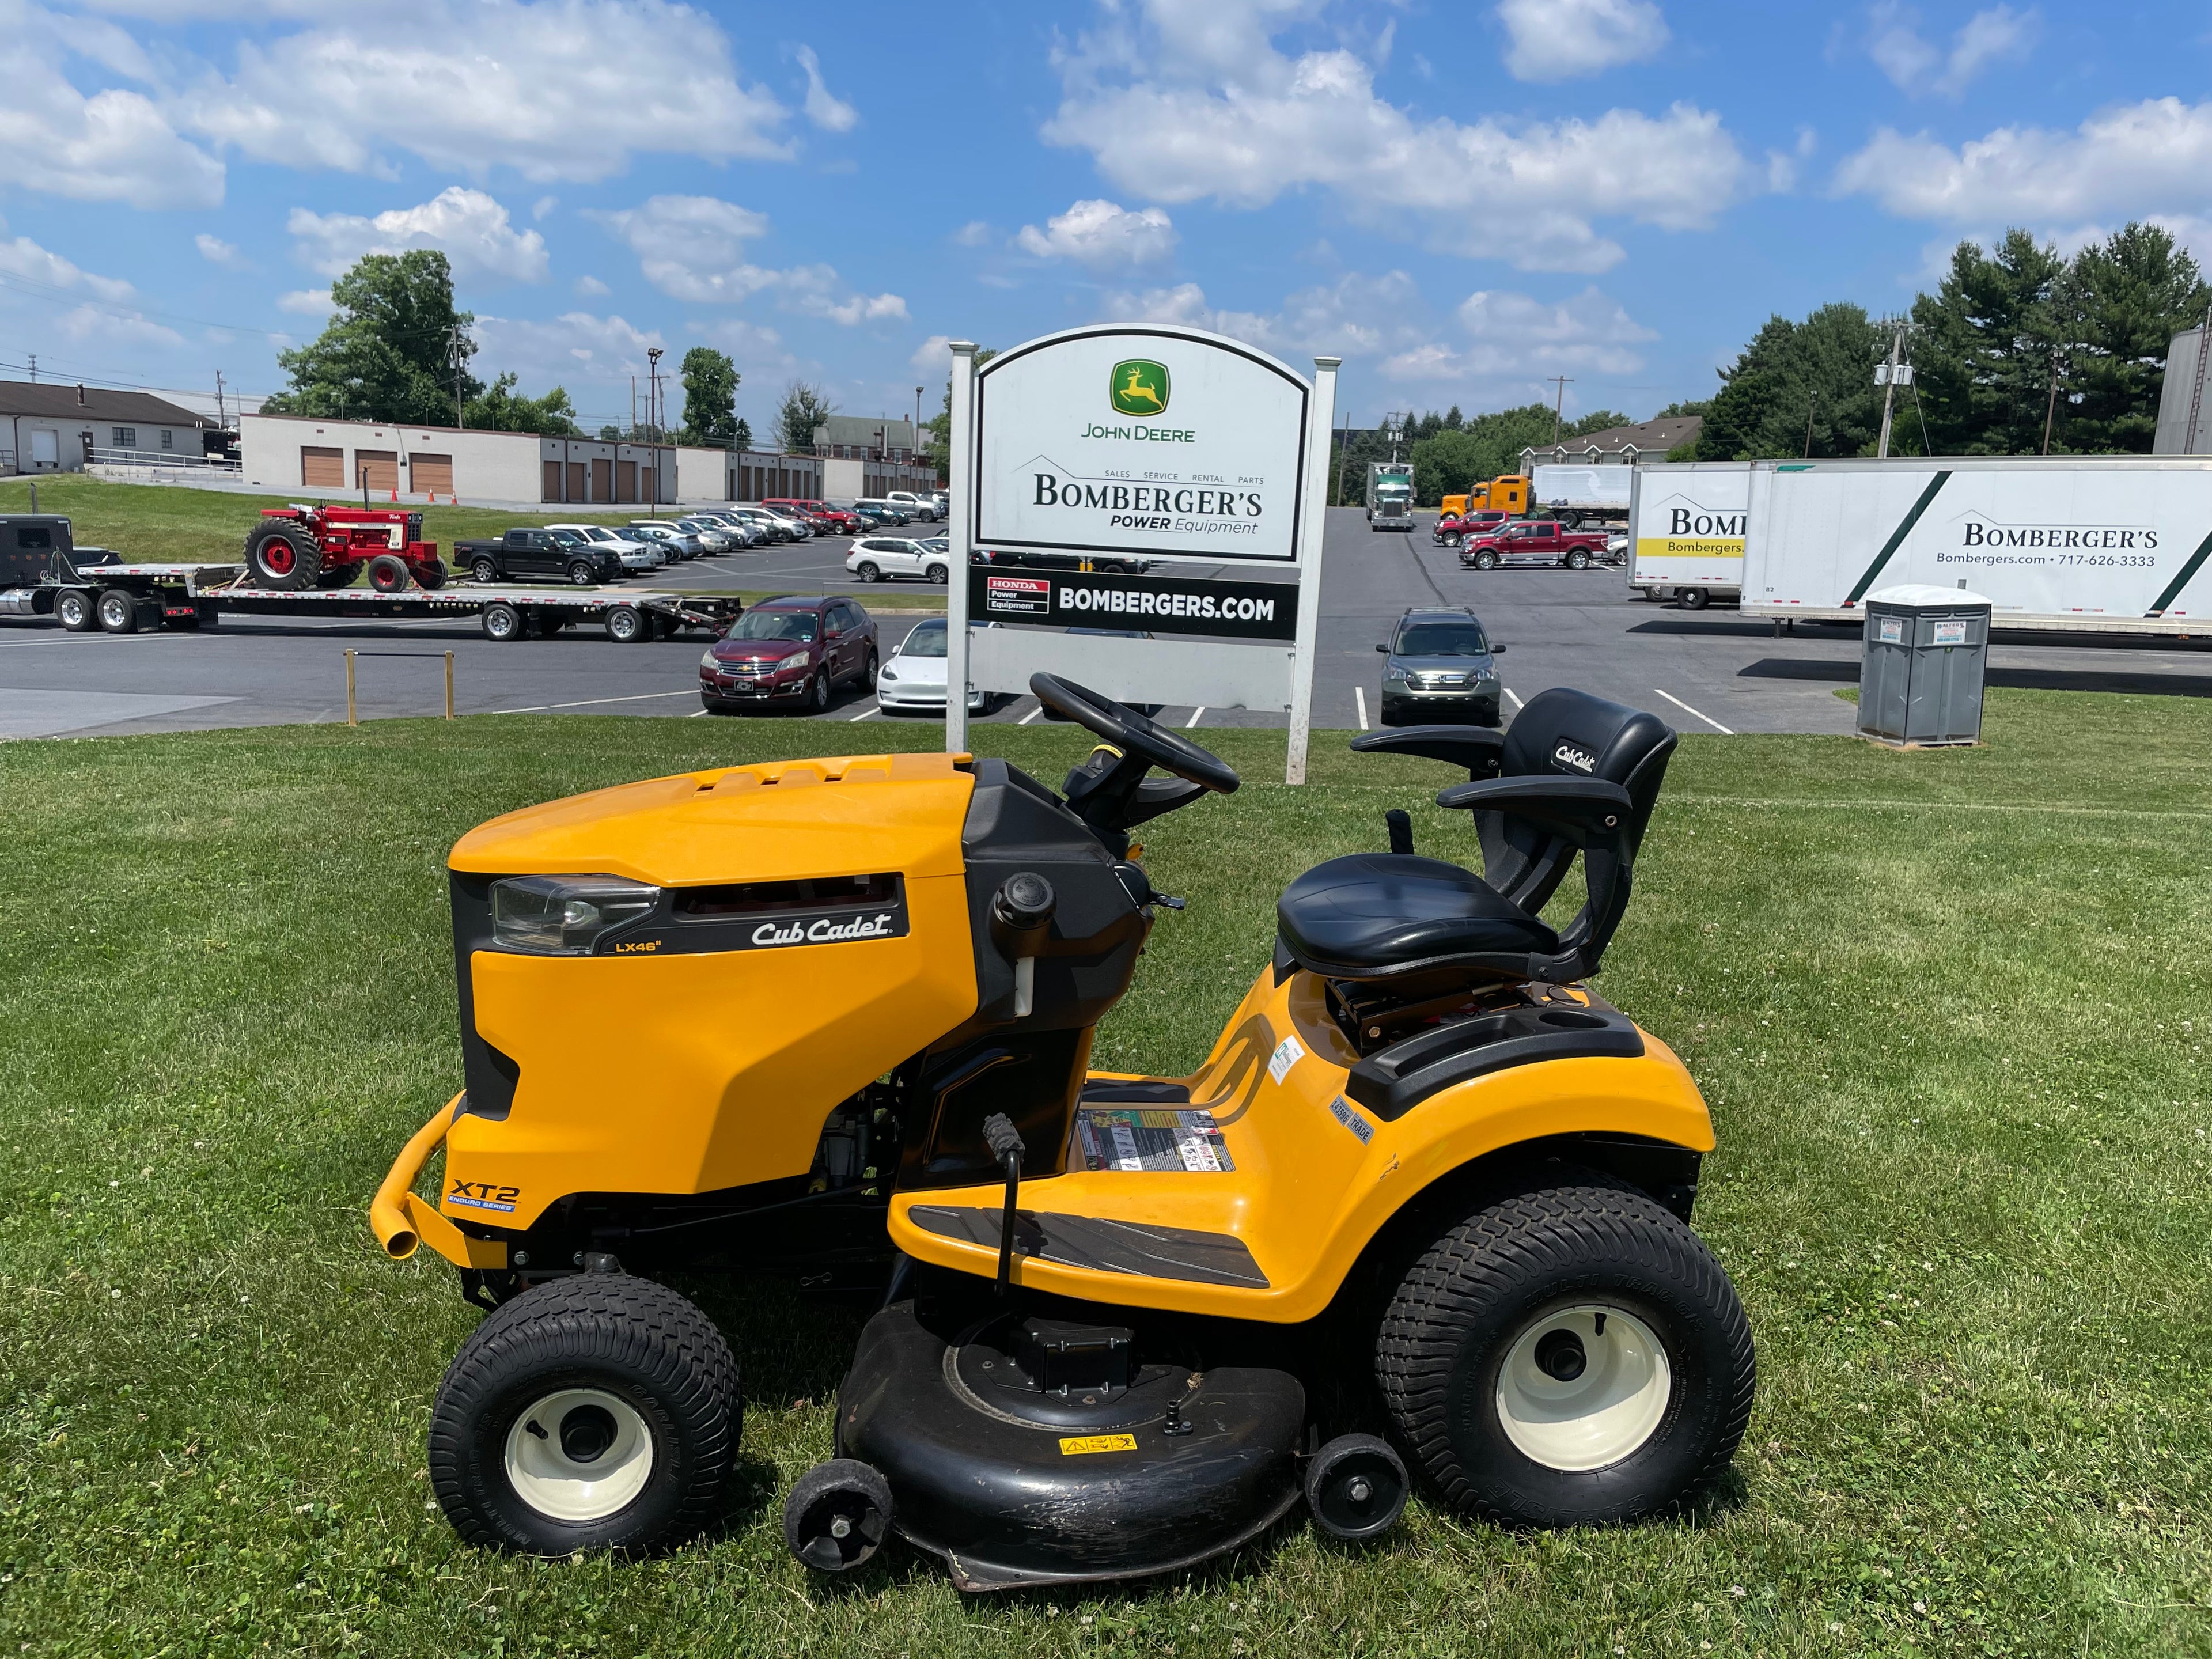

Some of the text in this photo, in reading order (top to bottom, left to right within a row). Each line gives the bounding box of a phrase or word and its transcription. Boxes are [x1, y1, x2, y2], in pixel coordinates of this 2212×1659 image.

[1081, 423, 1195, 442] JOHN DEERE
[1105, 469, 1264, 484] SALES SERVICE RENTAL PARTS
[1033, 474, 1263, 516] BOMBERGER'S
[1110, 515, 1259, 534] POWER Equipment
[1962, 522, 2158, 548] BOMBERGER'S
[1937, 552, 2156, 567] Bombergers.com 717-626-3333
[991, 580, 1038, 590] HONDA
[991, 590, 1017, 599] Power
[991, 600, 1035, 609] Equipment
[1059, 588, 1275, 621] BOMBERGERS.COM
[1556, 745, 1595, 772] Cub Cadet
[752, 914, 891, 945] Cub Cadet
[1331, 1101, 1349, 1123] 143596
[1350, 1118, 1370, 1141] TRADE
[449, 1179, 520, 1203] XT2
[449, 1196, 512, 1211] ENDURO SERIES
[1524, 1272, 1600, 1309] MULTI
[629, 1384, 682, 1493] CARLISLE
